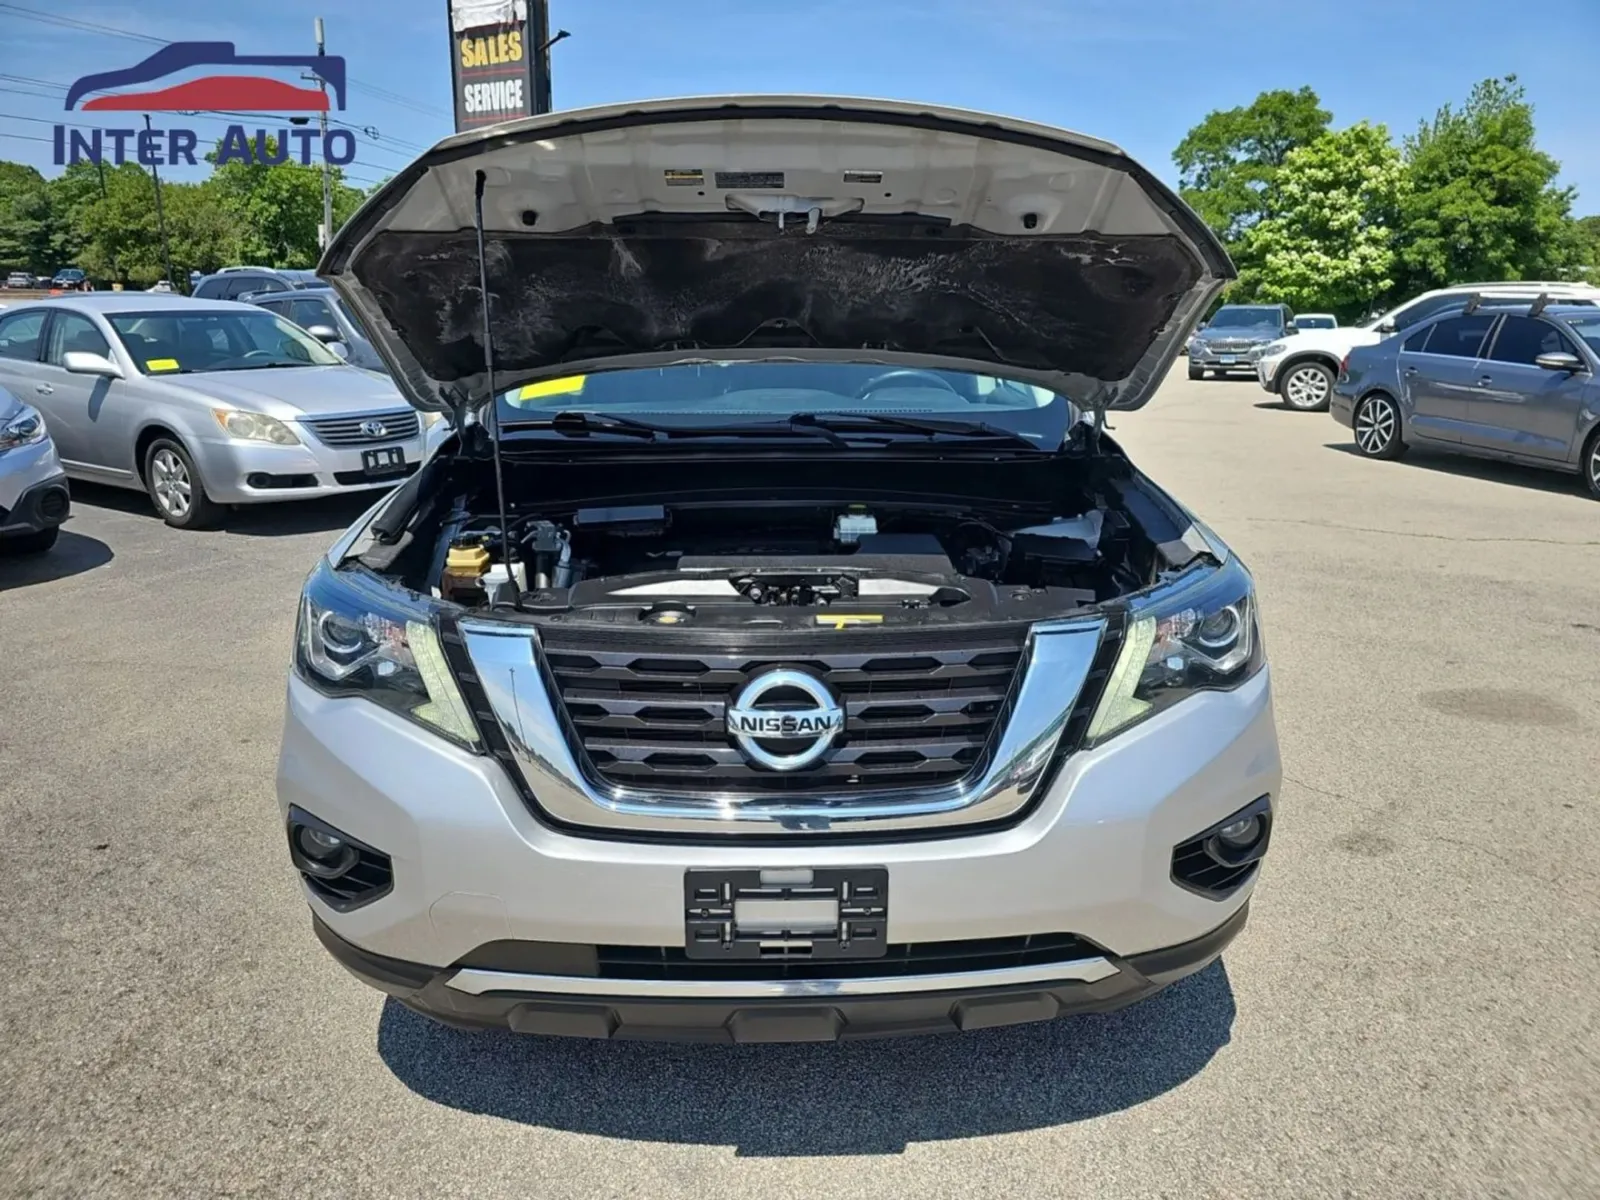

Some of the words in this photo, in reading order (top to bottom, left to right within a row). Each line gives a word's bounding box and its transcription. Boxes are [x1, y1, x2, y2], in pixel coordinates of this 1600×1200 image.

[460, 31, 522, 68] SALES
[464, 79, 523, 113] SERVICE
[740, 716, 832, 732] NISSAN
